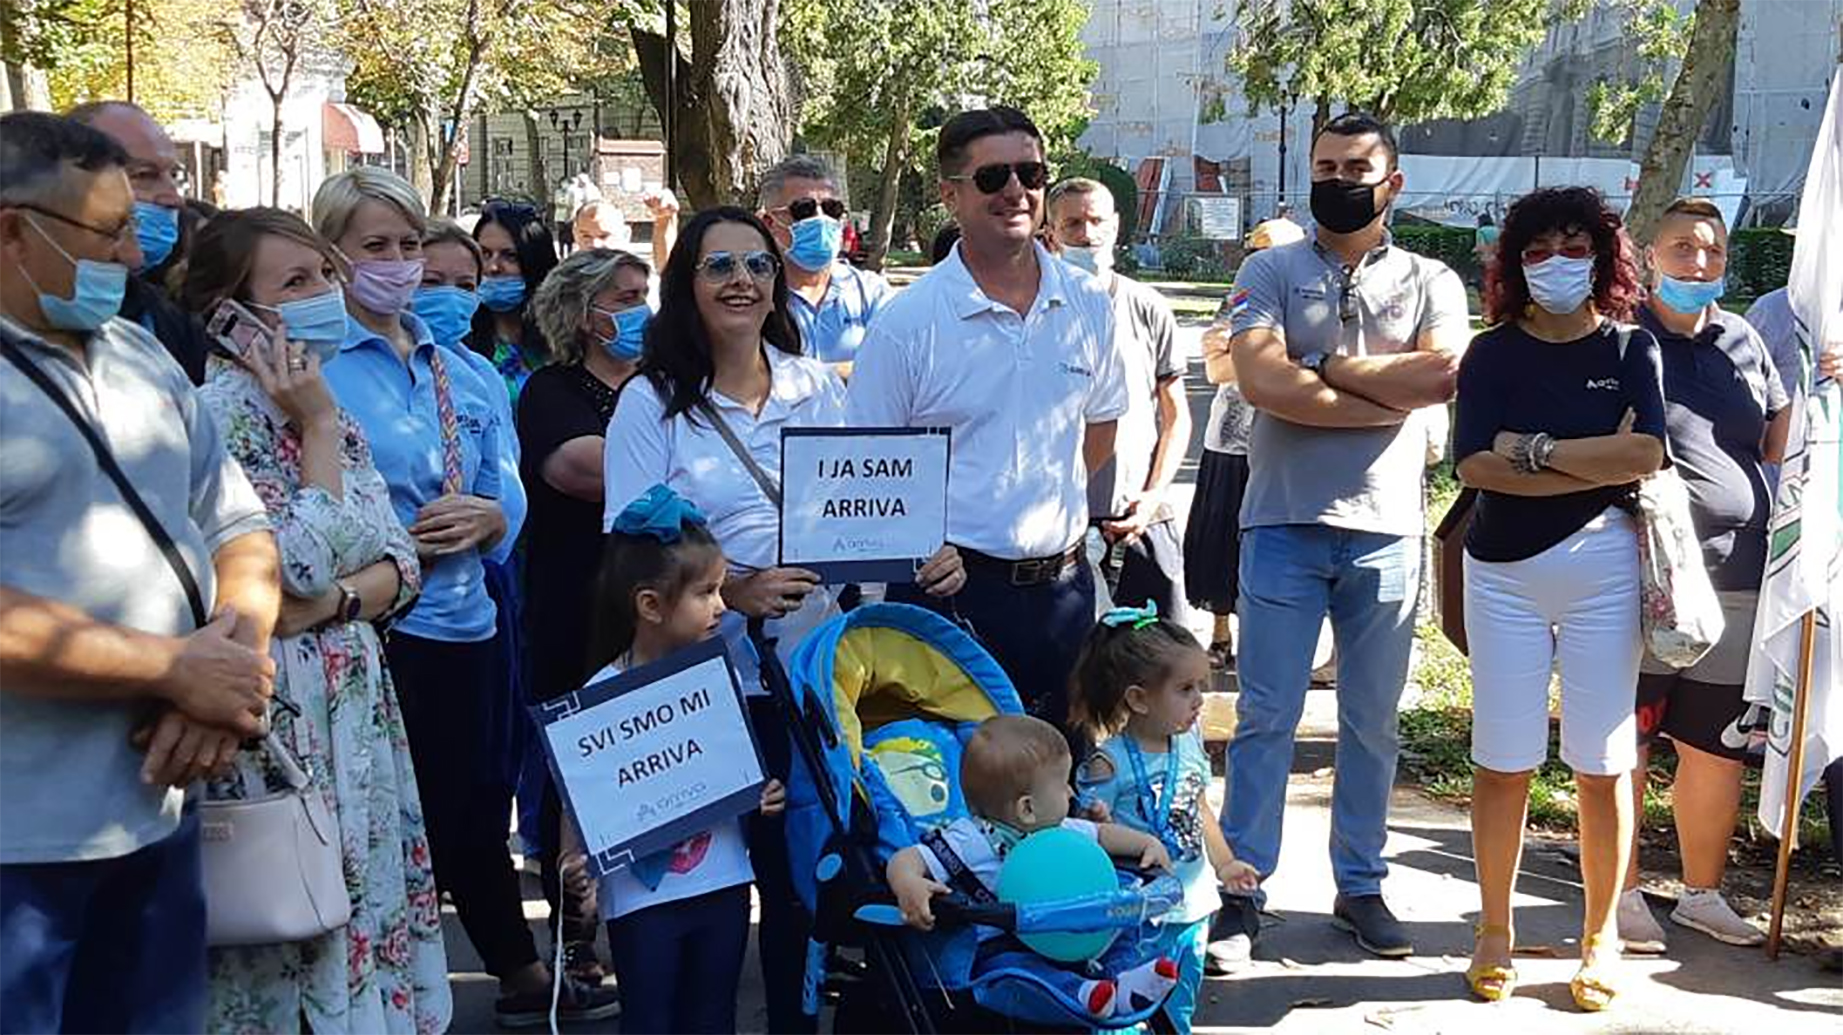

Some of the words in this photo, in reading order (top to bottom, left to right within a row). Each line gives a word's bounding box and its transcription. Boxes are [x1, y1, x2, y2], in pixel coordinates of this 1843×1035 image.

[819, 460, 824, 478] I
[831, 459, 855, 478] JA
[863, 458, 913, 478] SAM
[822, 498, 906, 518] ARRIVA
[577, 727, 616, 758] SVI
[619, 704, 674, 740] SMO
[680, 687, 711, 716] MI
[618, 738, 704, 788] ARRIVA
